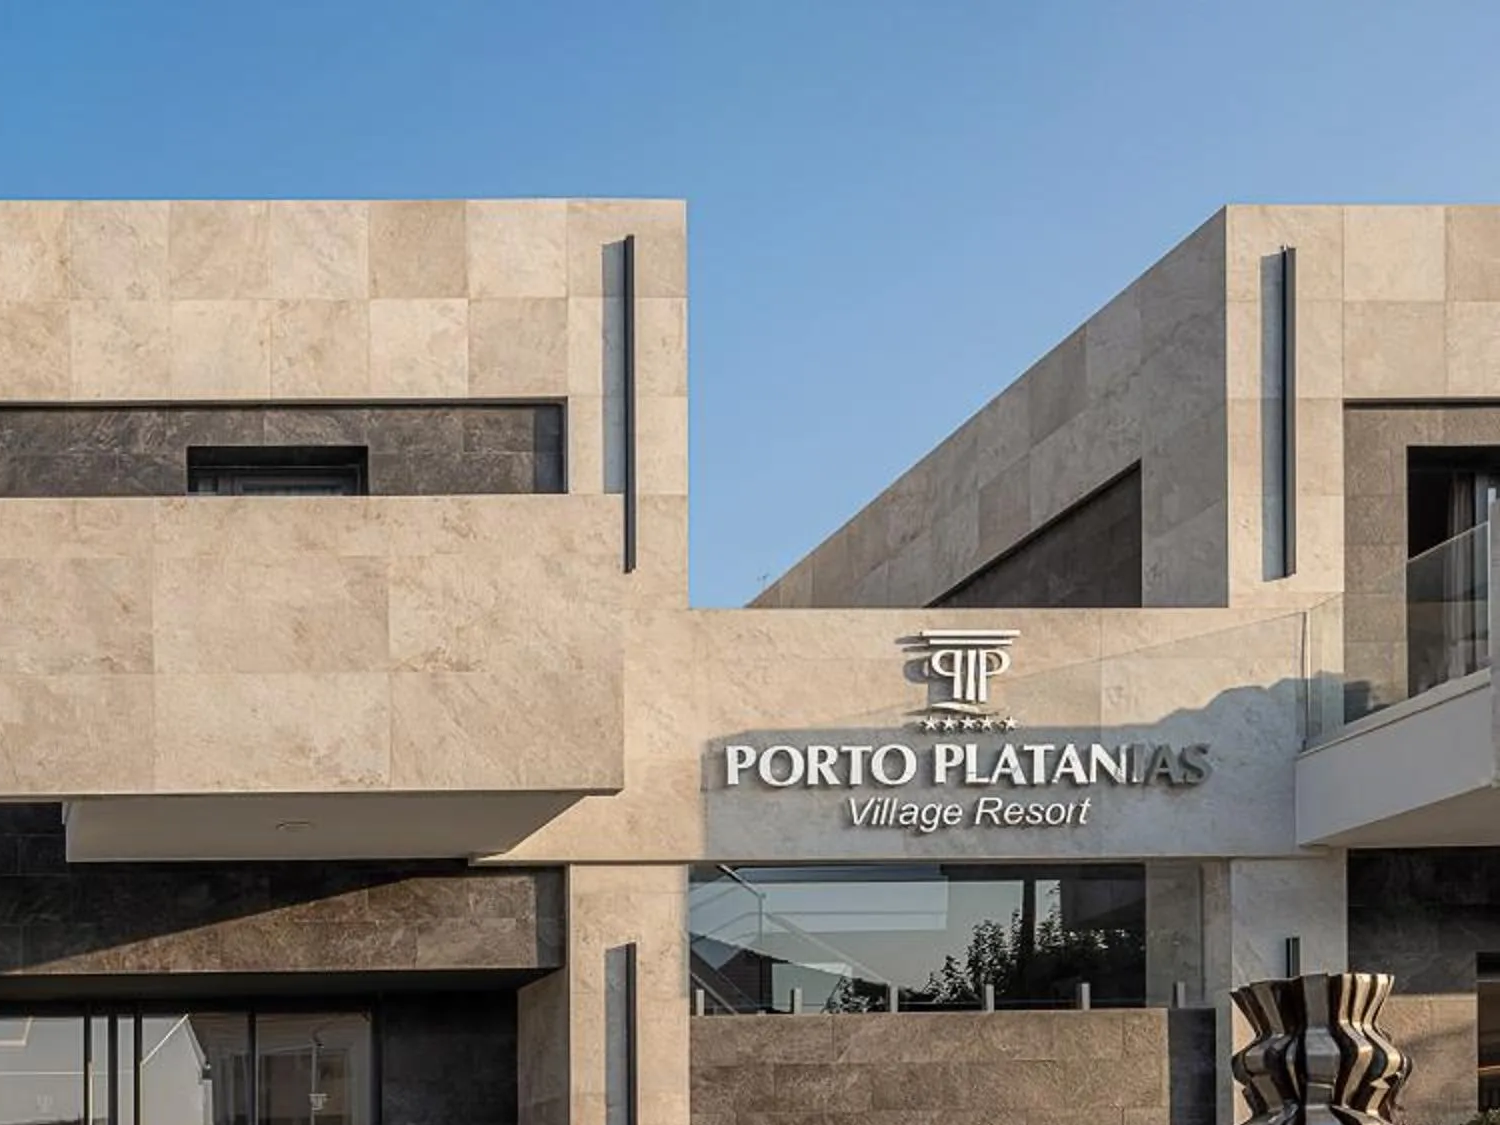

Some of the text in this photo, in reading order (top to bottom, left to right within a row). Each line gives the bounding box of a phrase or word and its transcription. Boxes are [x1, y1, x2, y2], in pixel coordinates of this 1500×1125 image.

[726, 743, 1211, 787] PORTO PLATANIAS
[850, 797, 1092, 833] Village Resort
